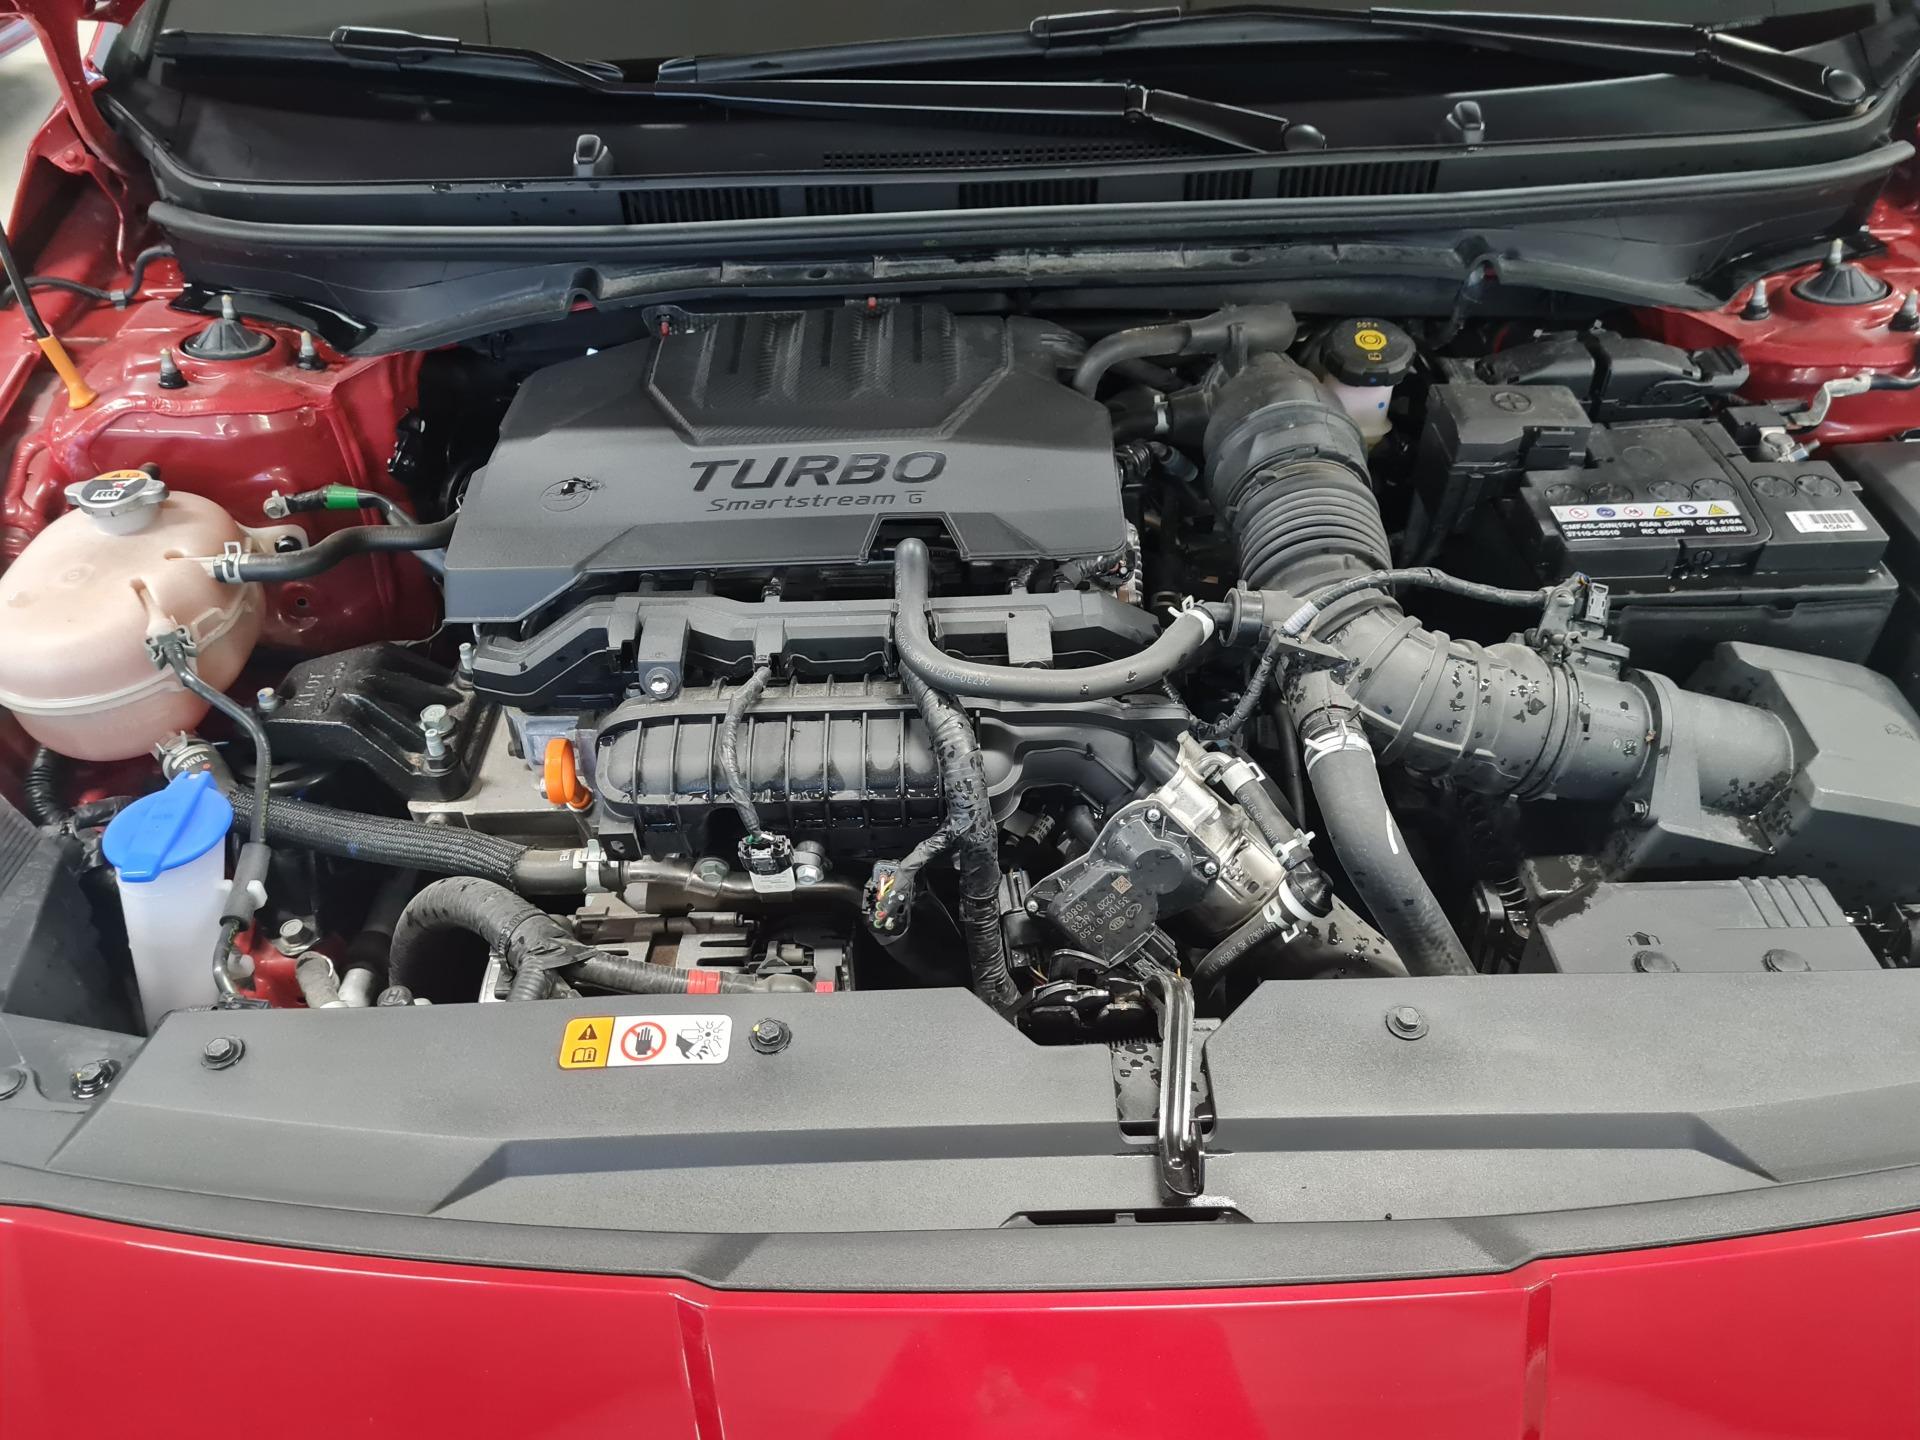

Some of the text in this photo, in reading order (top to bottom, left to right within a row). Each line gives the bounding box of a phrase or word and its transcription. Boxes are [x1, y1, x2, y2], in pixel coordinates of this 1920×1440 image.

[689, 451, 947, 492] TURBO
[706, 494, 895, 512] Smartstream
[1696, 518, 1718, 526] CCA
[1640, 527, 1656, 535] RC
[180, 753, 209, 769] TANK
[1096, 892, 1116, 911] 6220
